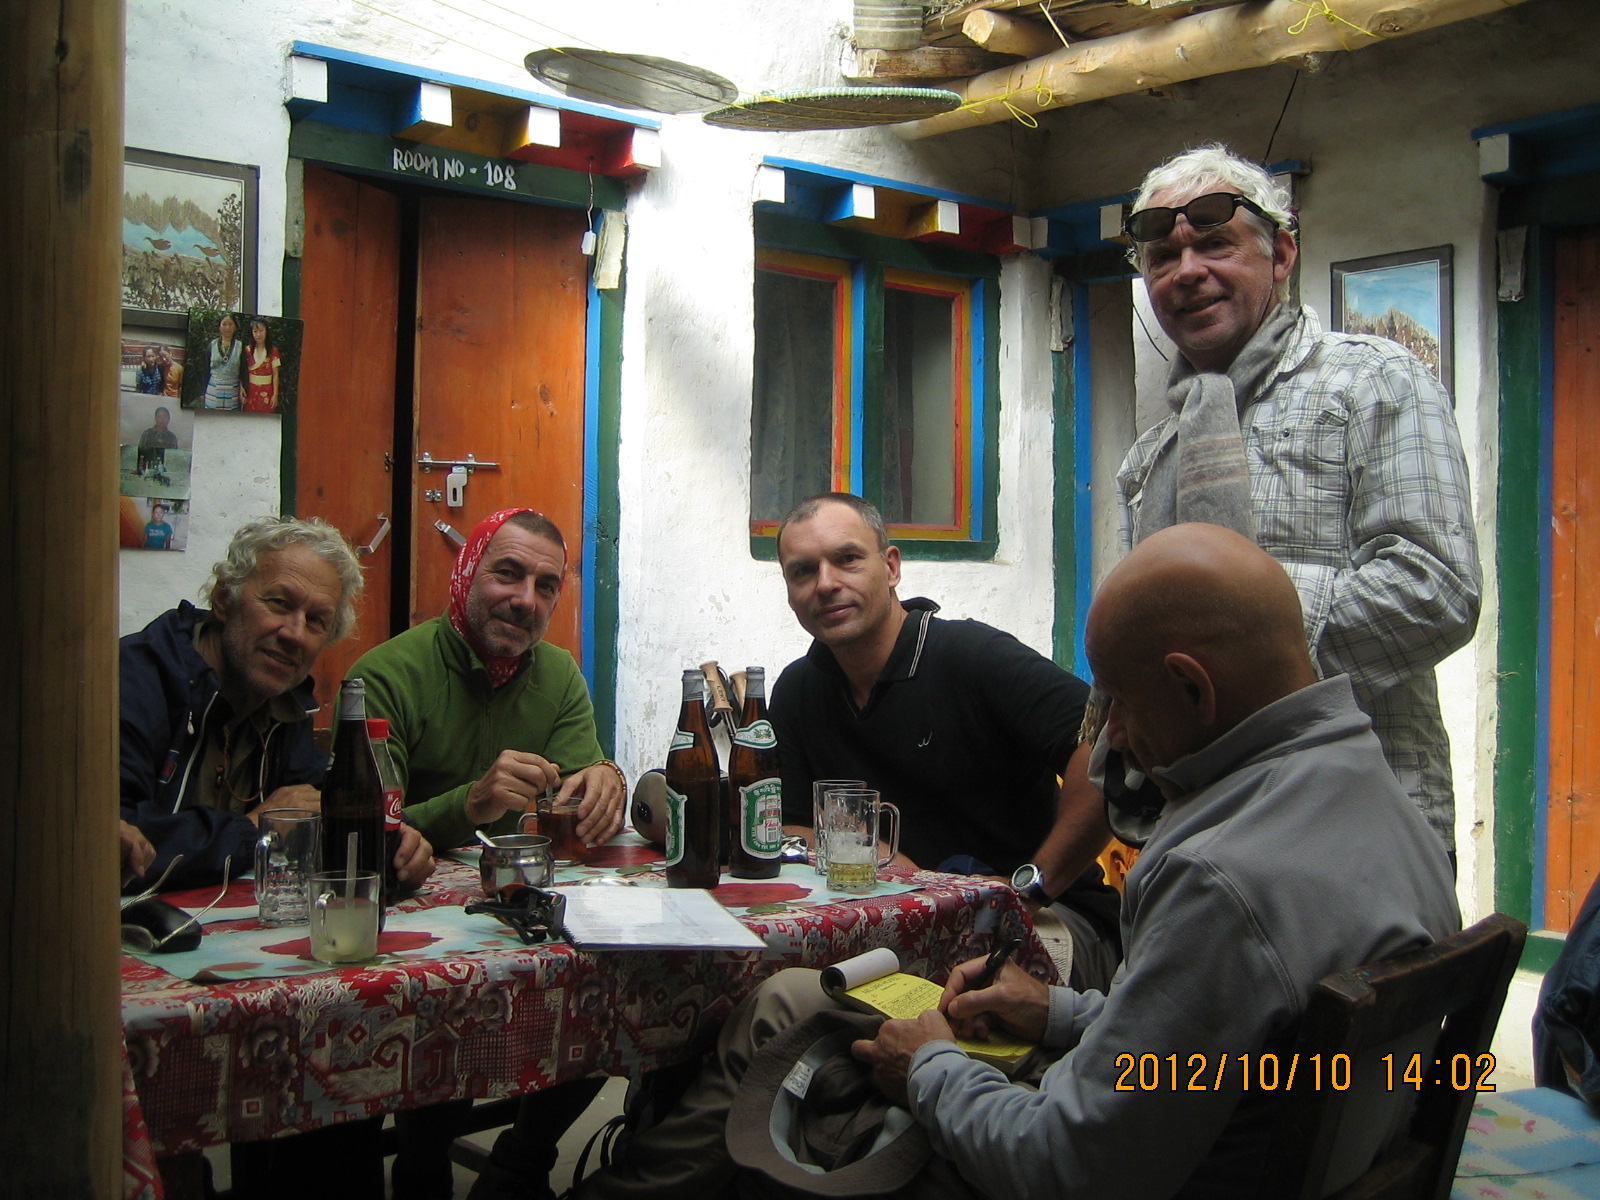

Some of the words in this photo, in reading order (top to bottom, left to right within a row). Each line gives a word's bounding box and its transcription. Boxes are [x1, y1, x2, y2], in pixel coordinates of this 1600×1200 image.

[393, 147, 438, 178] ROOM
[443, 158, 464, 180] NO
[483, 161, 516, 190] 108
